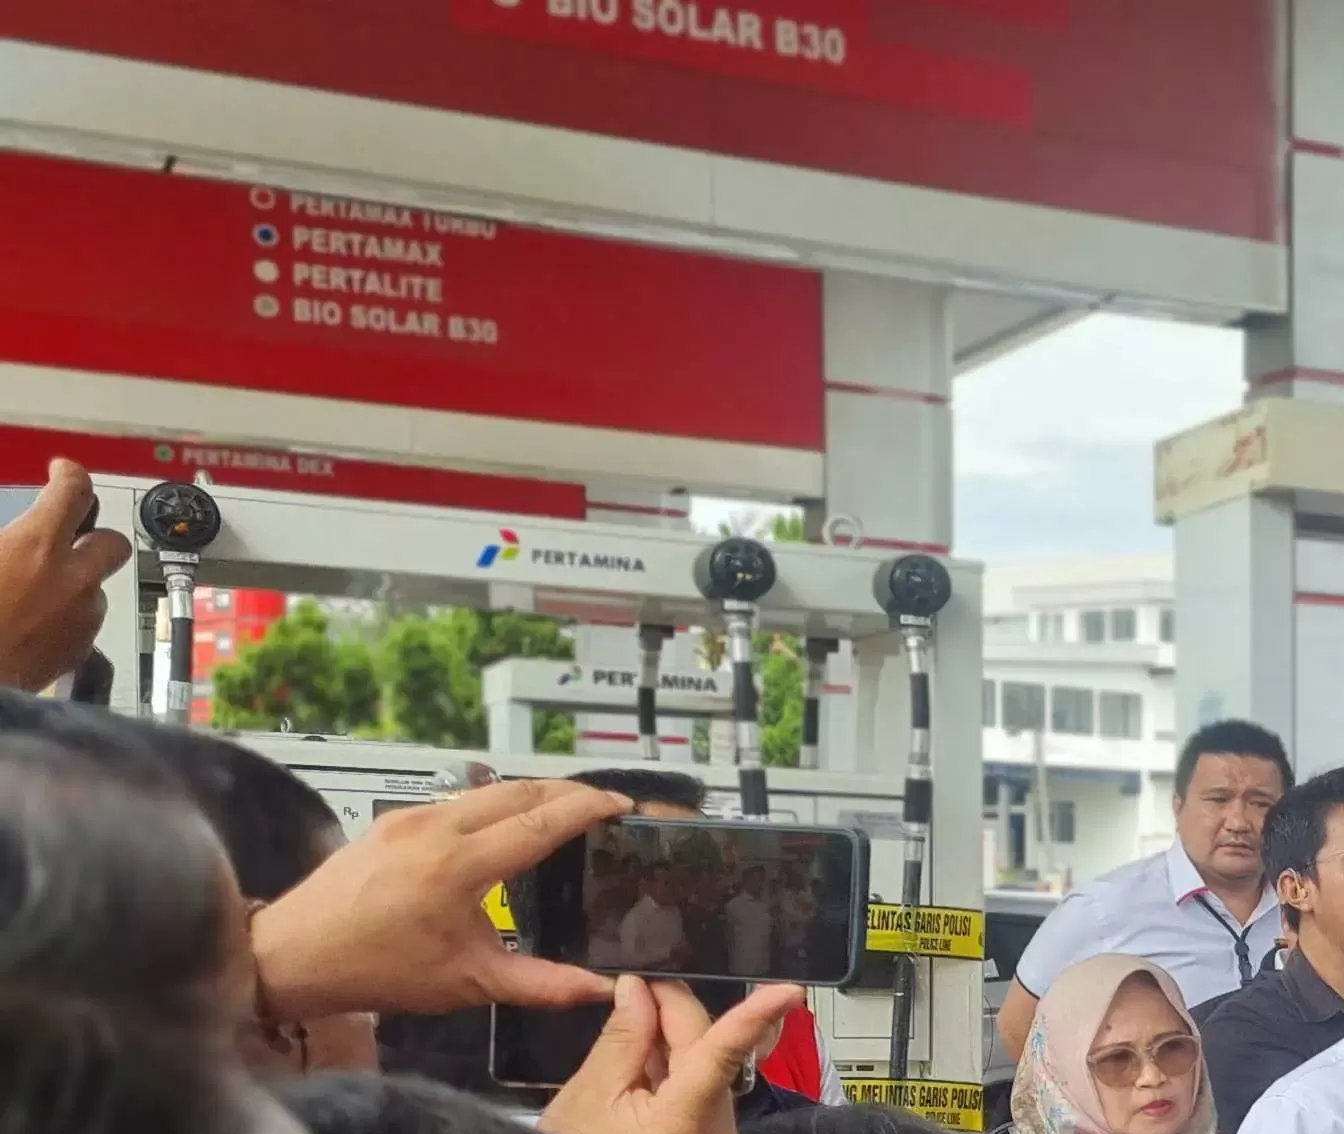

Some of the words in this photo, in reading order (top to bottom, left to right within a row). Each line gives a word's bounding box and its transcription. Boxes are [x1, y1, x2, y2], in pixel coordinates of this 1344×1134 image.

[631, 0, 763, 50] SOLAR
[775, 19, 846, 64] B30
[292, 225, 443, 267] PERTAMAX
[292, 262, 443, 303] PERTALITE
[293, 297, 342, 326] BIO
[350, 304, 441, 338] SOLAR
[448, 315, 499, 344] B30
[531, 549, 646, 573] PERTAMINA
[593, 669, 718, 693] PERMINA
[914, 911, 942, 934] GARIS
[943, 912, 972, 937] POLISI
[919, 1086, 949, 1108] GARIS
[951, 1088, 984, 1111] POLISI
